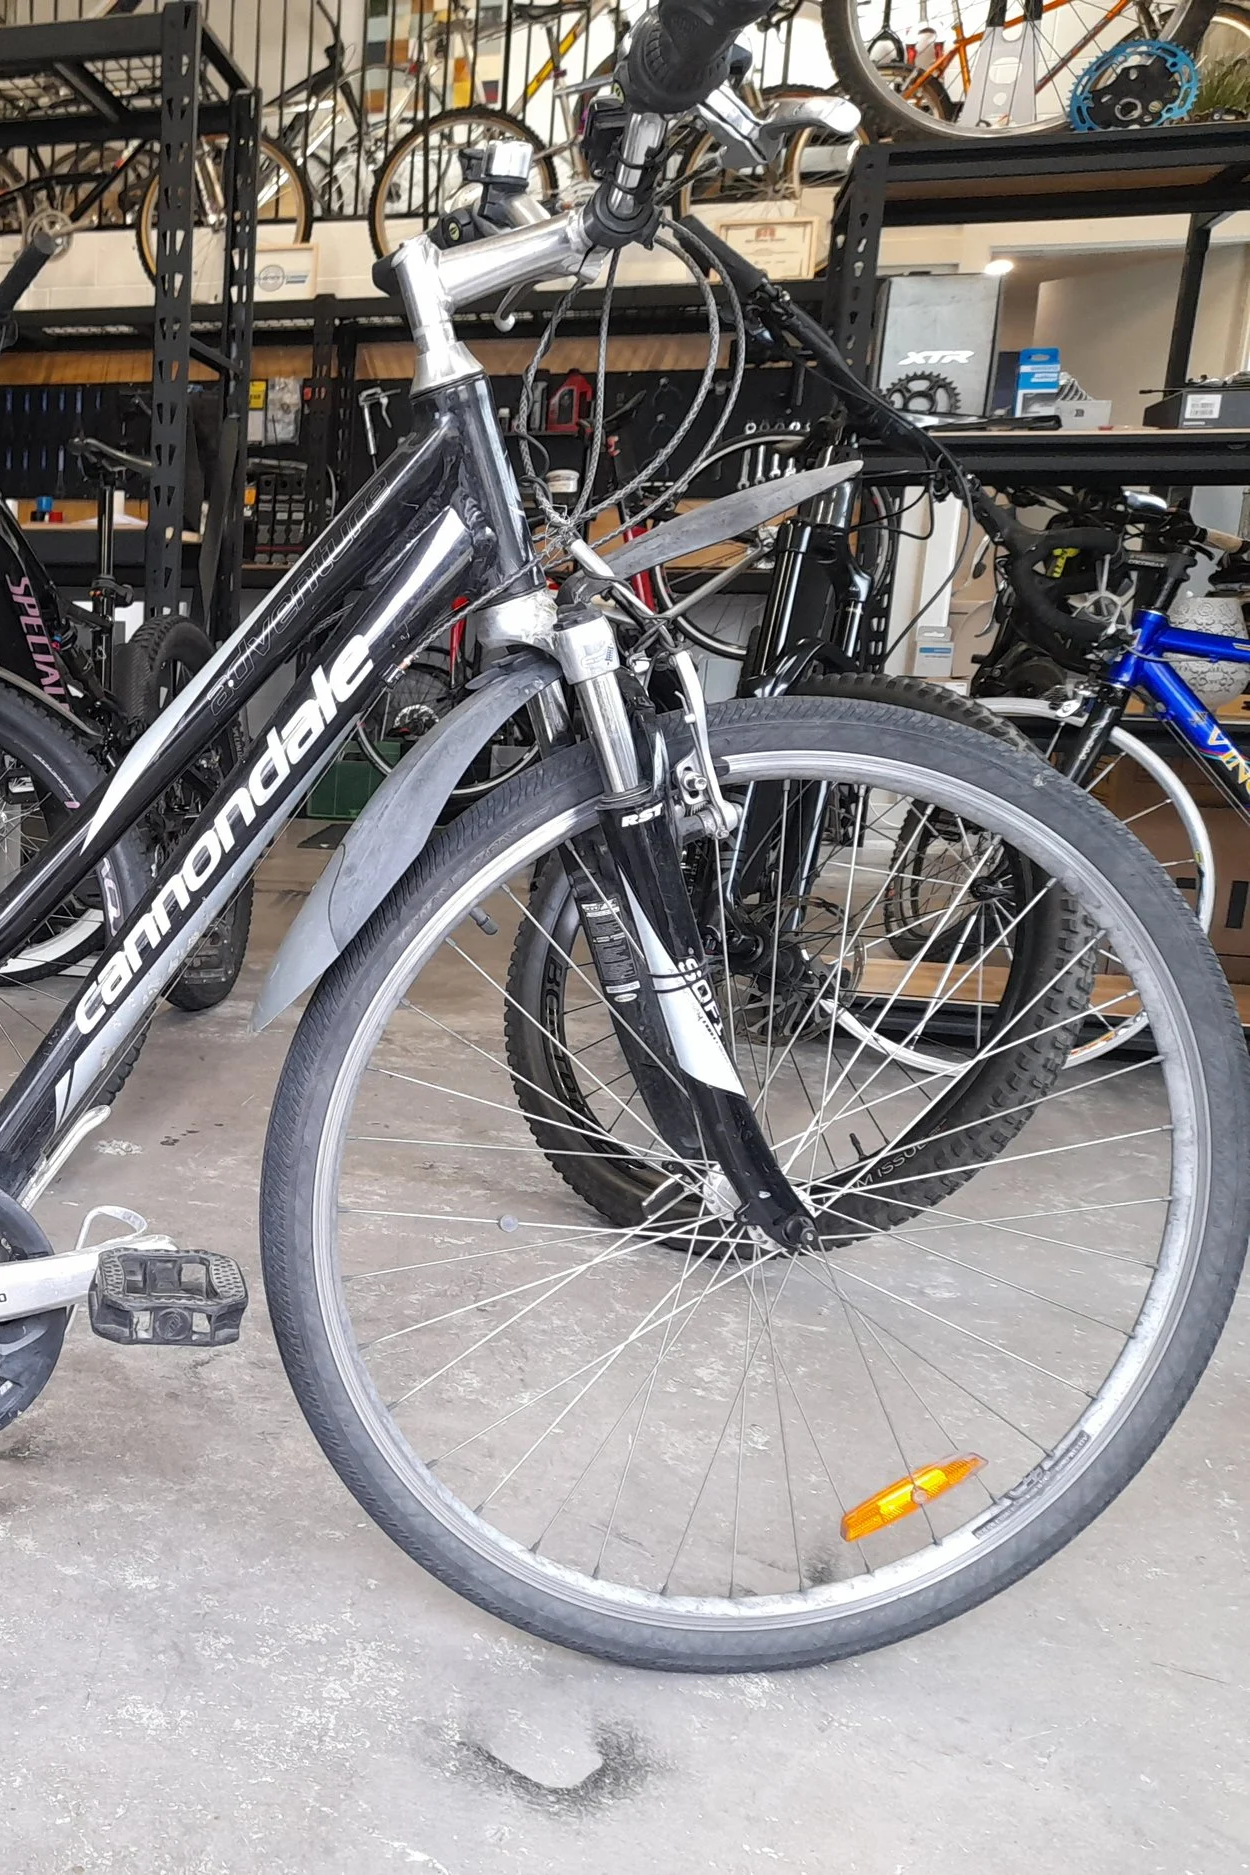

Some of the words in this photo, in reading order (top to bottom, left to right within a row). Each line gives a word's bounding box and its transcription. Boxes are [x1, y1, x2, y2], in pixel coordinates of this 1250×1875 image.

[897, 349, 975, 366] XTR
[208, 476, 392, 717] adventure
[75, 633, 376, 1035] cannondale
[621, 802, 664, 827] RST
